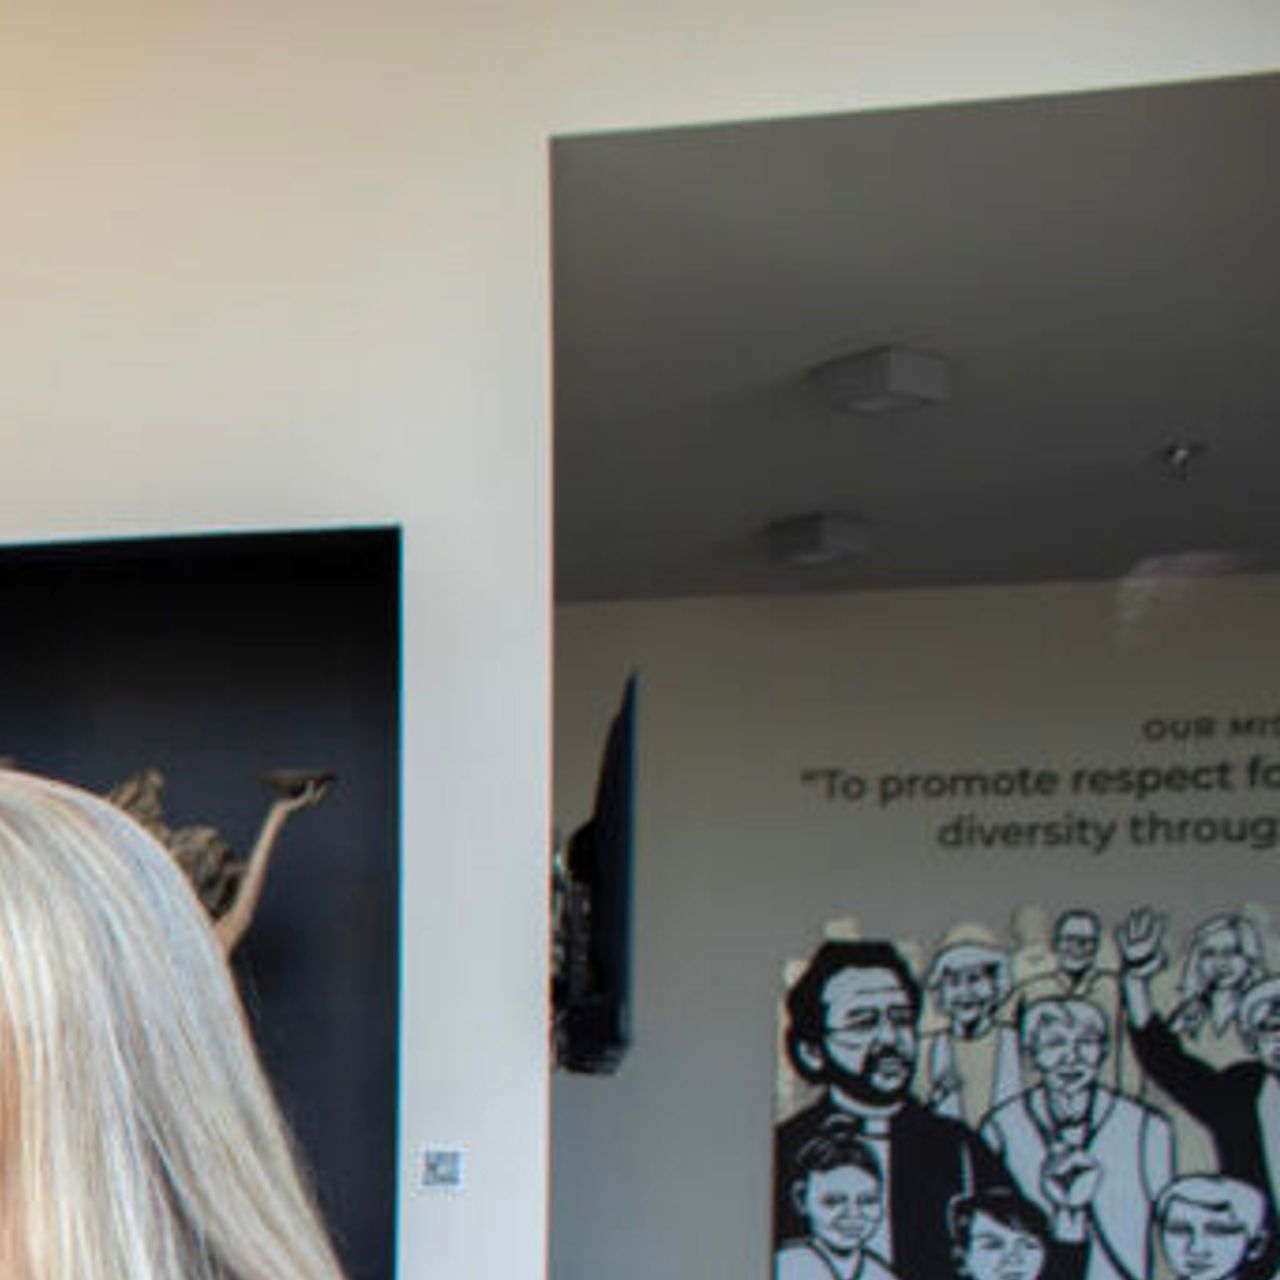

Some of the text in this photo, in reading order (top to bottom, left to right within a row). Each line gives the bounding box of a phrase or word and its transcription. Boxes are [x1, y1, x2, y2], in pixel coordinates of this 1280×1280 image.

[1143, 717, 1216, 741] OUR
[879, 768, 1059, 808] promote
[1071, 761, 1233, 800] respect
[937, 811, 1280, 854] diversity throug
